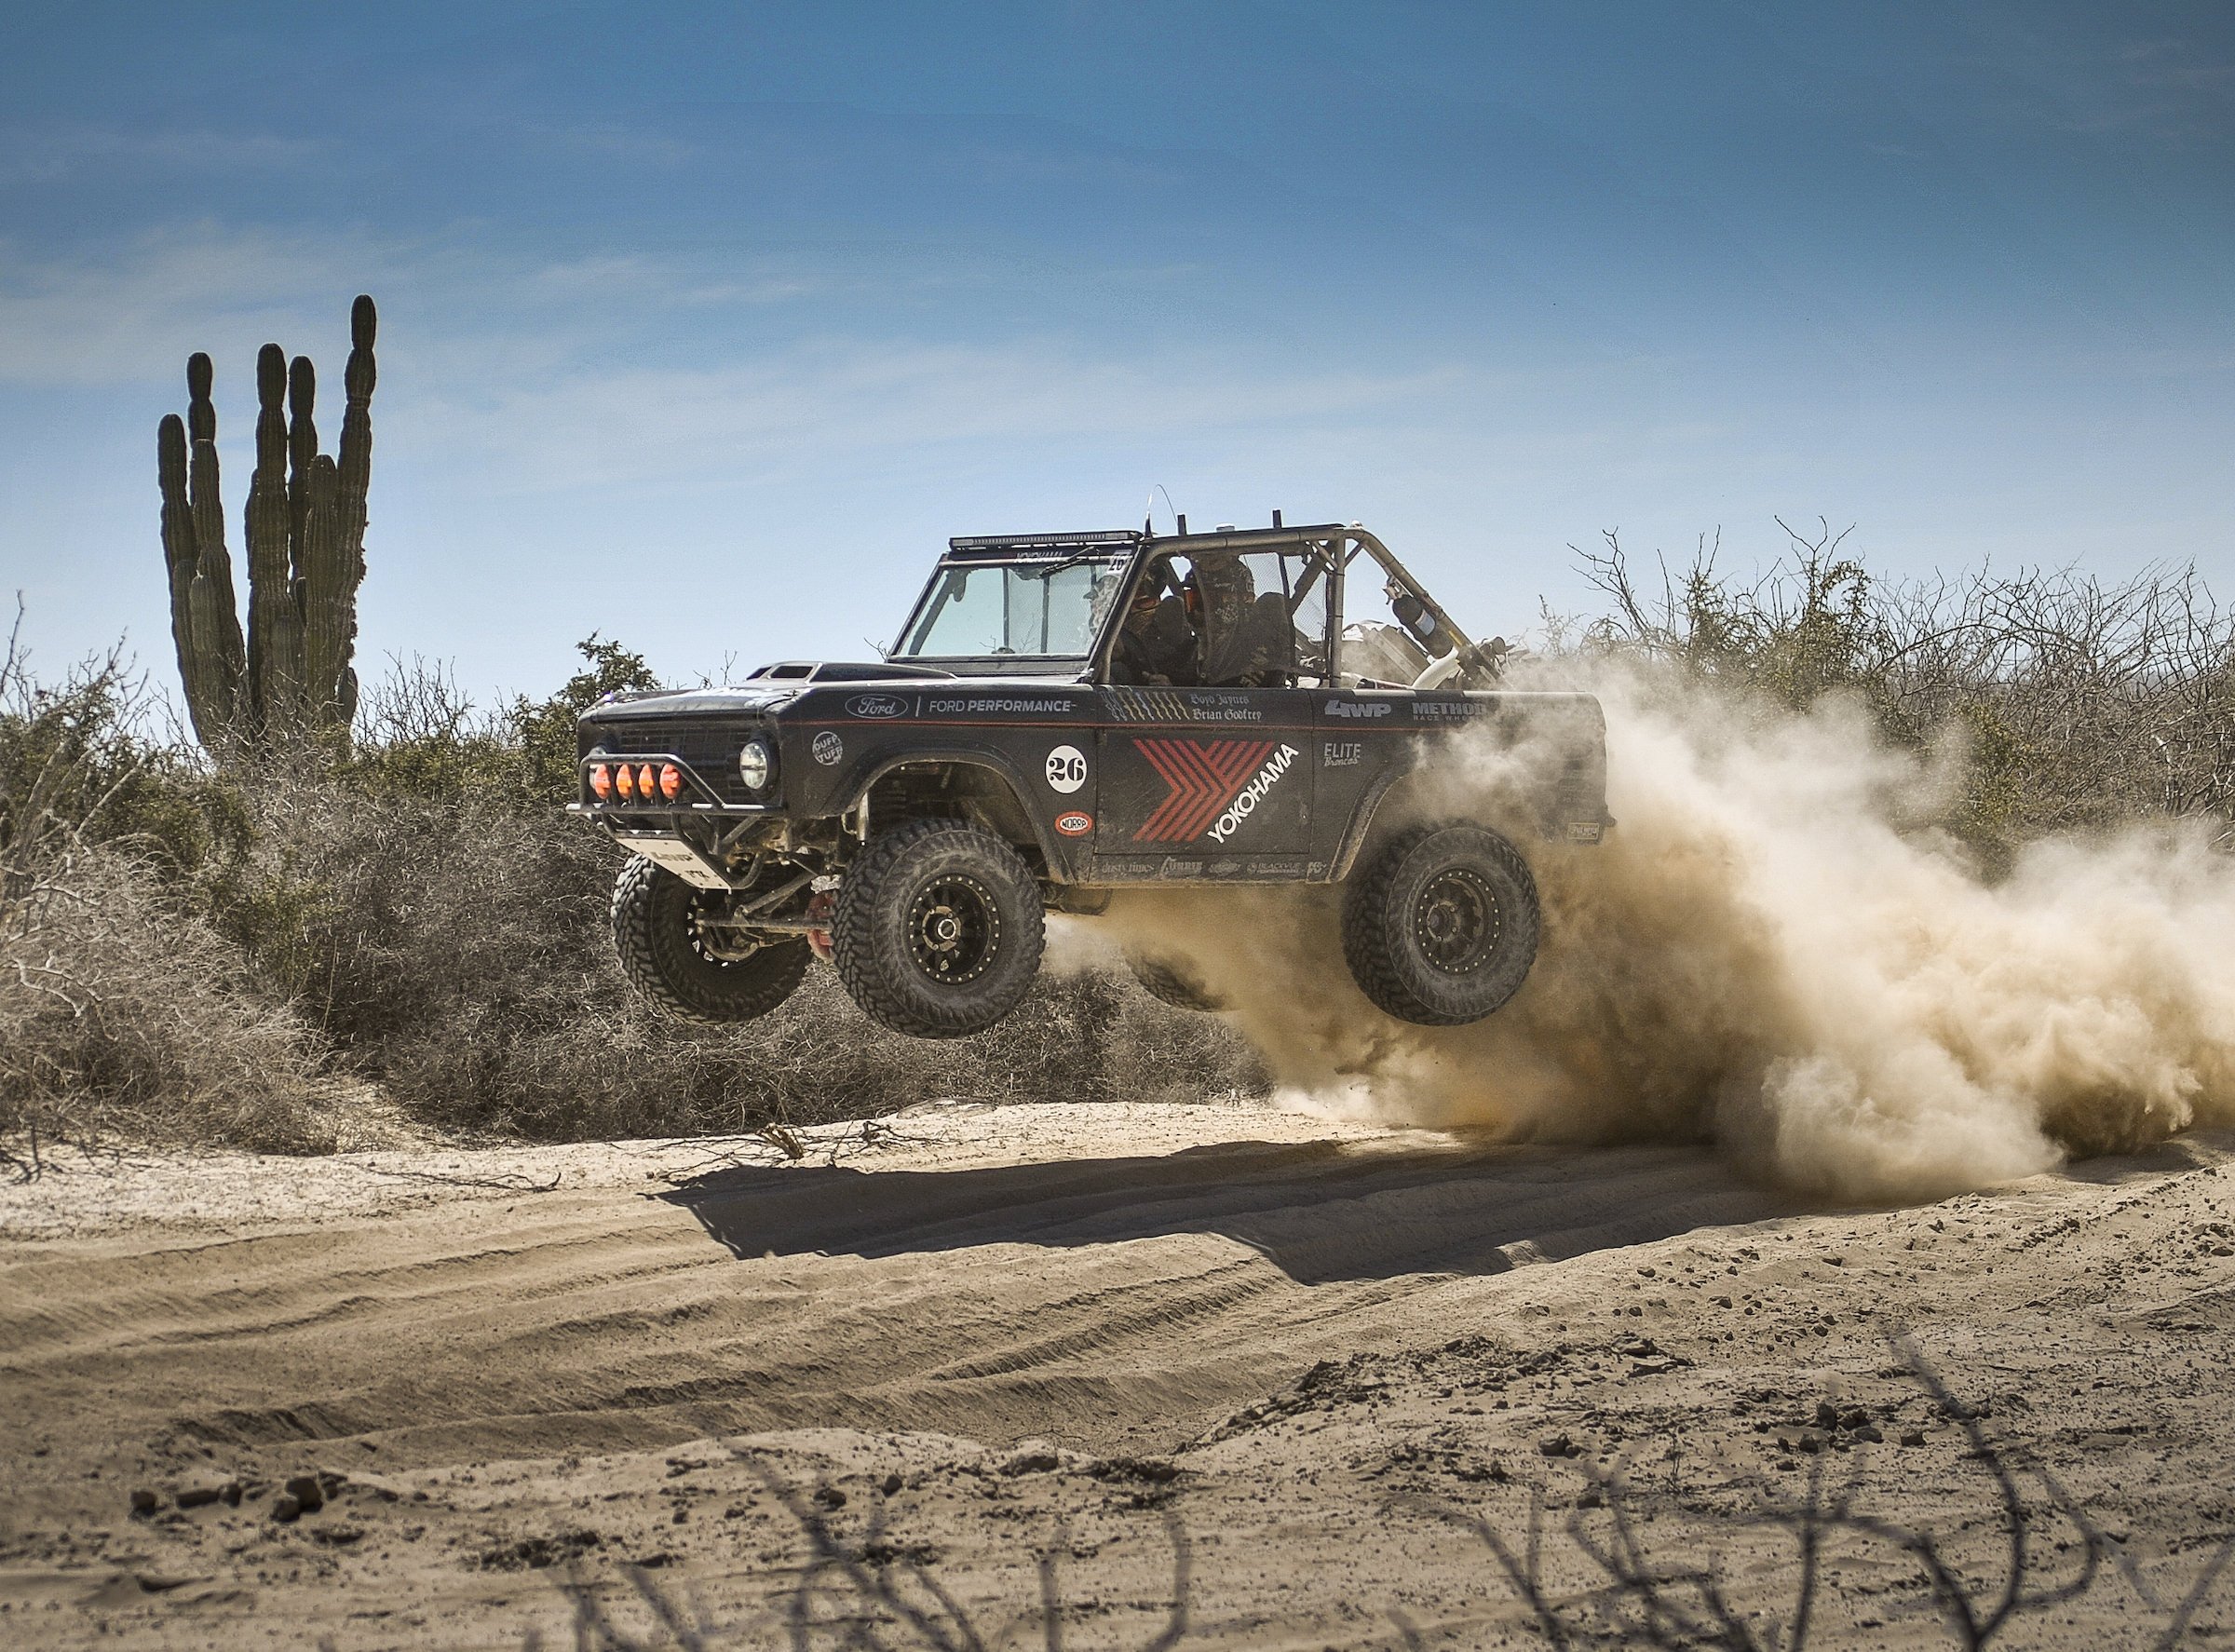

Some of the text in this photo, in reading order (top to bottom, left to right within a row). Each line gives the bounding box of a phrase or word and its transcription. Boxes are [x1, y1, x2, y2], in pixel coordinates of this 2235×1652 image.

[857, 697, 896, 715] Ford
[929, 699, 1070, 712] FORD PERFORMANCE
[1192, 708, 1263, 723] Brian Godfrey
[814, 735, 839, 752] DUFF
[1324, 742, 1361, 759] ELITE
[815, 746, 843, 764] TUFF
[1323, 756, 1359, 766] Broncos
[1049, 757, 1084, 782] 26
[1207, 743, 1299, 844] YOKOHAMA
